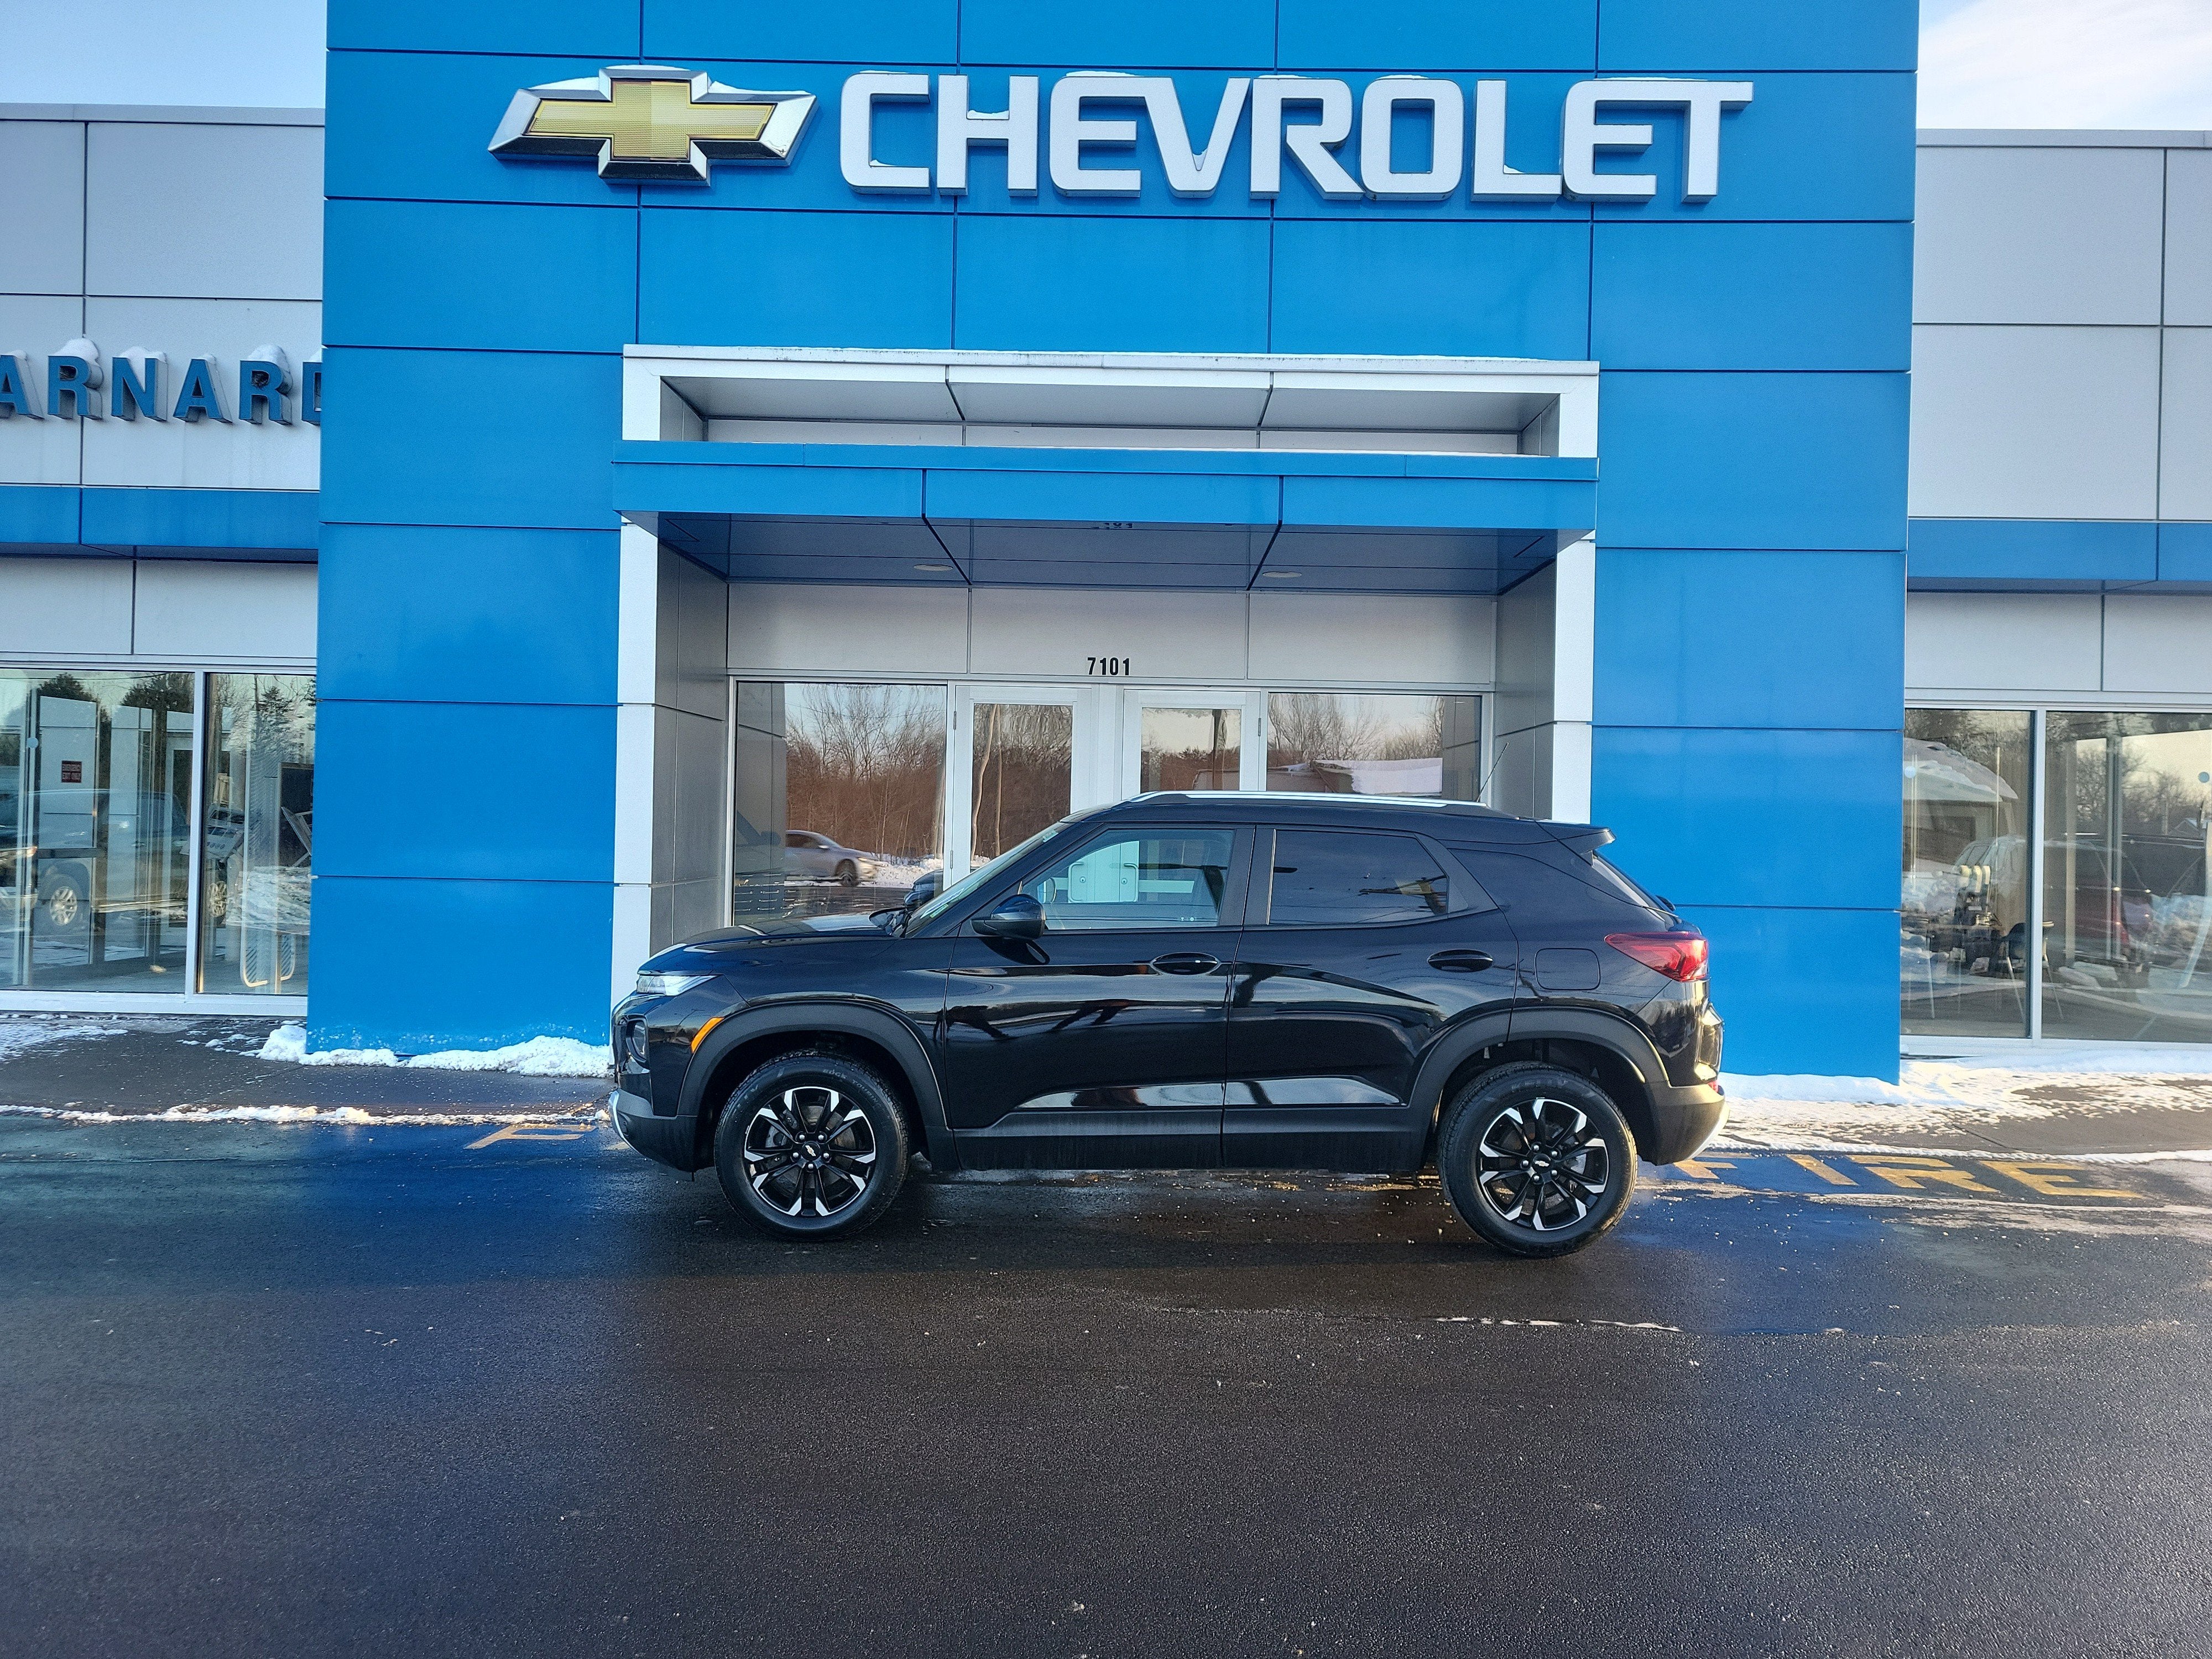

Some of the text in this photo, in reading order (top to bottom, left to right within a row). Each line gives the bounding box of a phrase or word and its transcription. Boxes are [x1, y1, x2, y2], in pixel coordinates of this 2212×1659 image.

[840, 72, 1753, 202] CHEVROLET
[1087, 657, 1130, 676] 7101
[1673, 1151, 2144, 1198] FIRE
